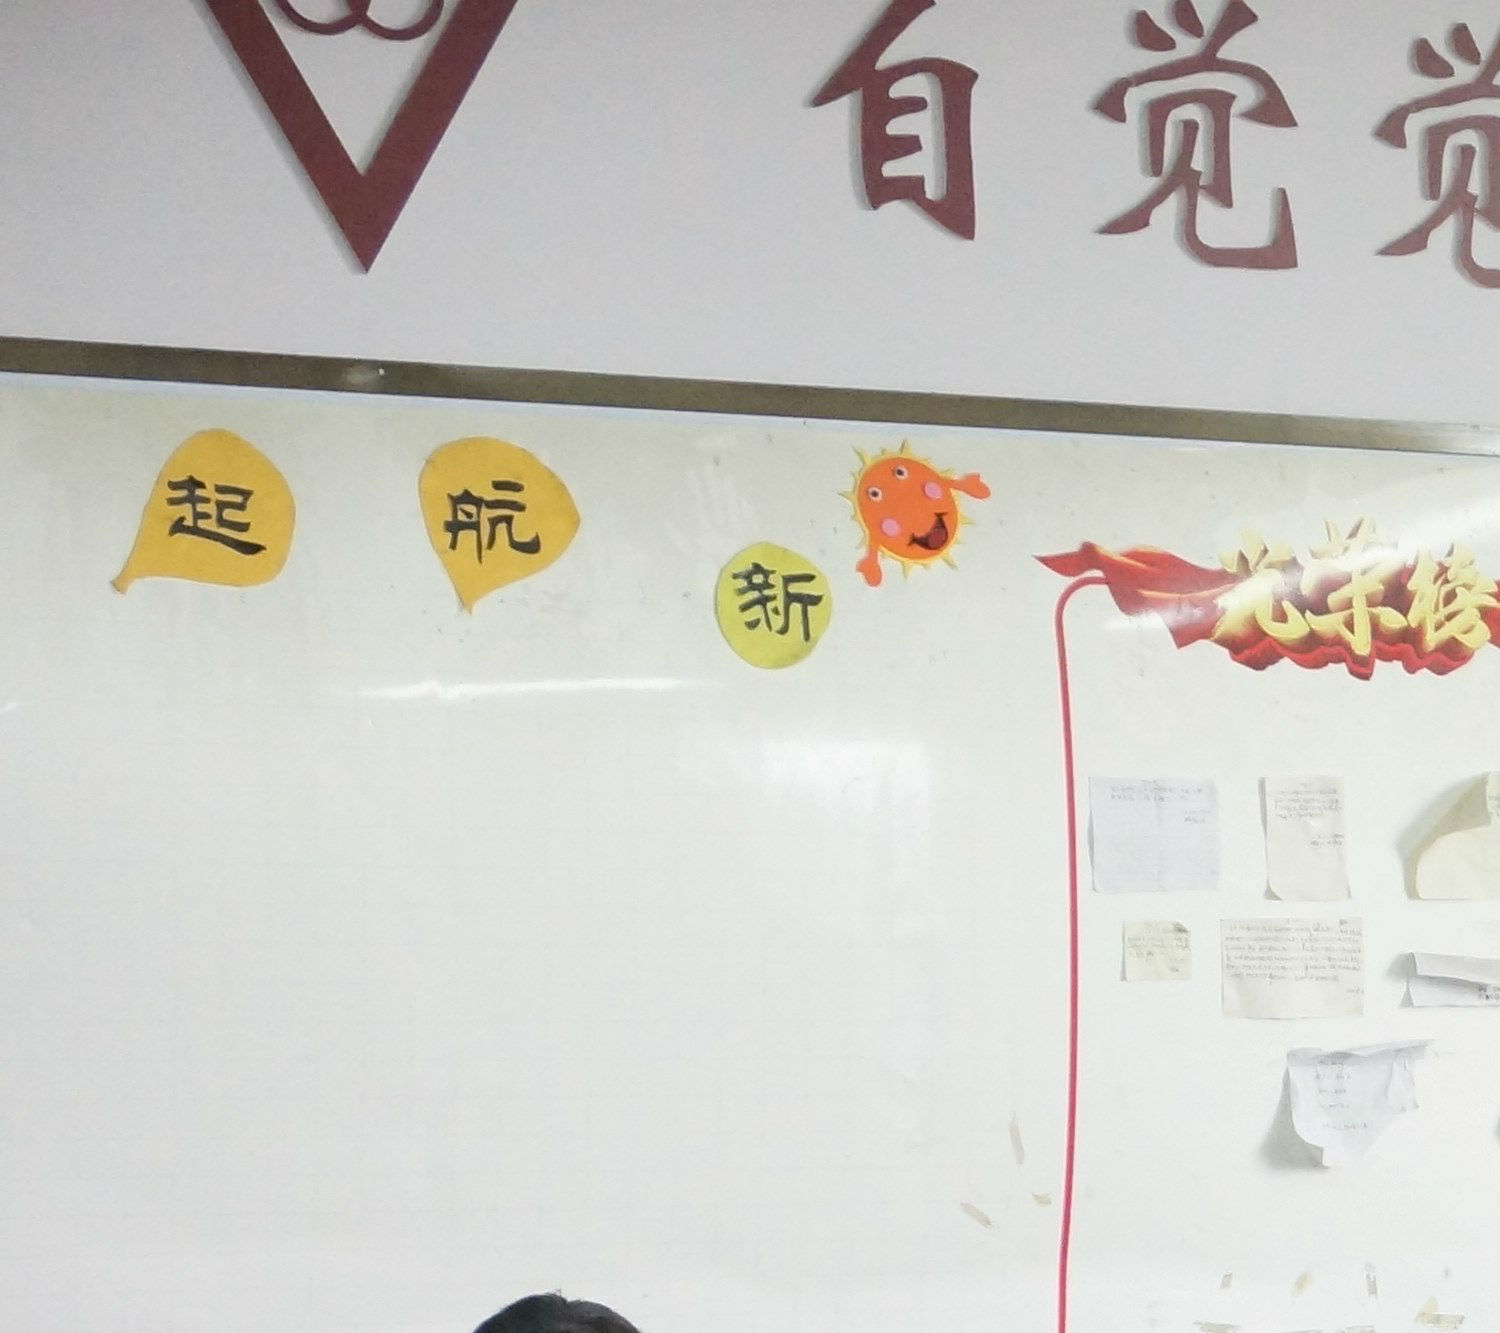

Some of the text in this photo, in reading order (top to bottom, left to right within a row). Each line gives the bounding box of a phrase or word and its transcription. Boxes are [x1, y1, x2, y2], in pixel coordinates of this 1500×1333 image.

[167, 475, 541, 562] 起 航
[730, 562, 824, 641] 新
[1212, 516, 1498, 656] 光荣榜
